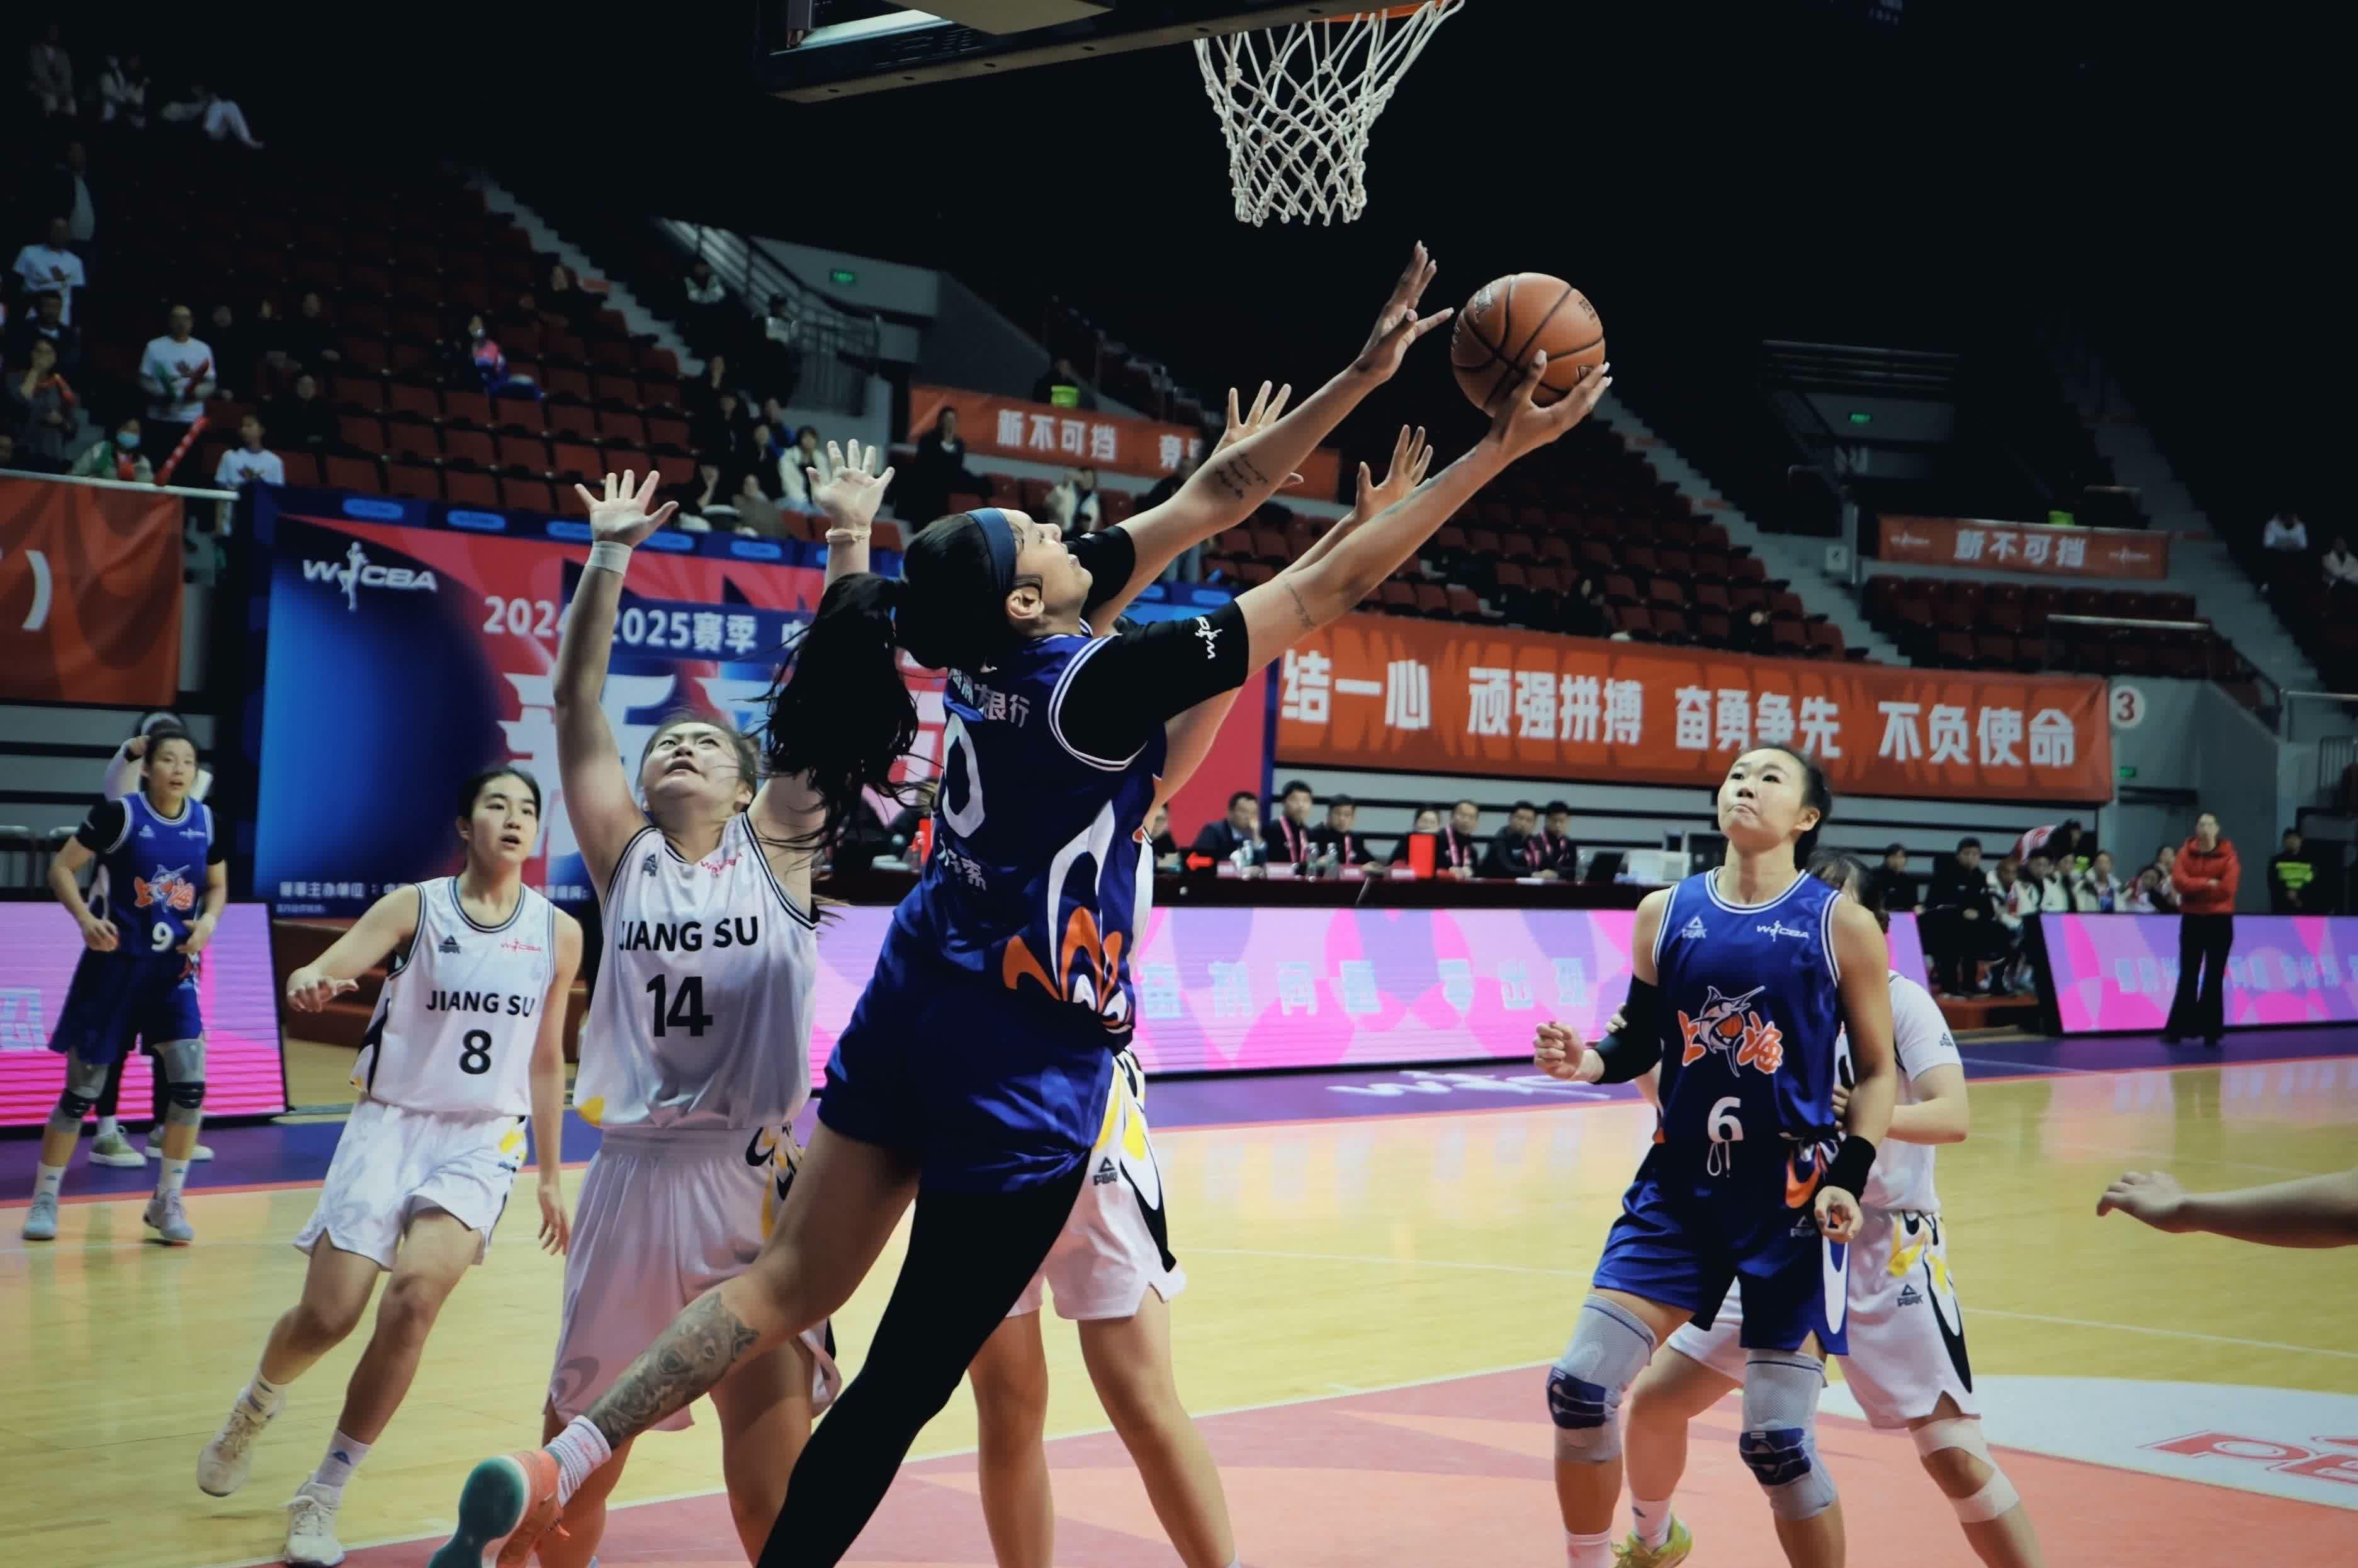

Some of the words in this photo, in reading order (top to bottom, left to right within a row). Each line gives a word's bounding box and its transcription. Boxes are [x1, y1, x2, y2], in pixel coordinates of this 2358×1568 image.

[303, 558, 438, 593] WCBA
[1467, 666, 1643, 745] 顽强拼搏
[1674, 685, 1842, 758] 奋勇争先
[1878, 700, 2076, 767] 不负使命
[2116, 691, 2135, 721] 3
[151, 922, 173, 952] 9
[713, 917, 758, 947] SU
[1756, 925, 1810, 939] WCBA
[426, 990, 499, 1013] JIANG
[506, 995, 535, 1017] SU
[646, 974, 713, 1037] 14
[458, 1029, 492, 1075] 8
[1707, 1097, 1744, 1142] 6
